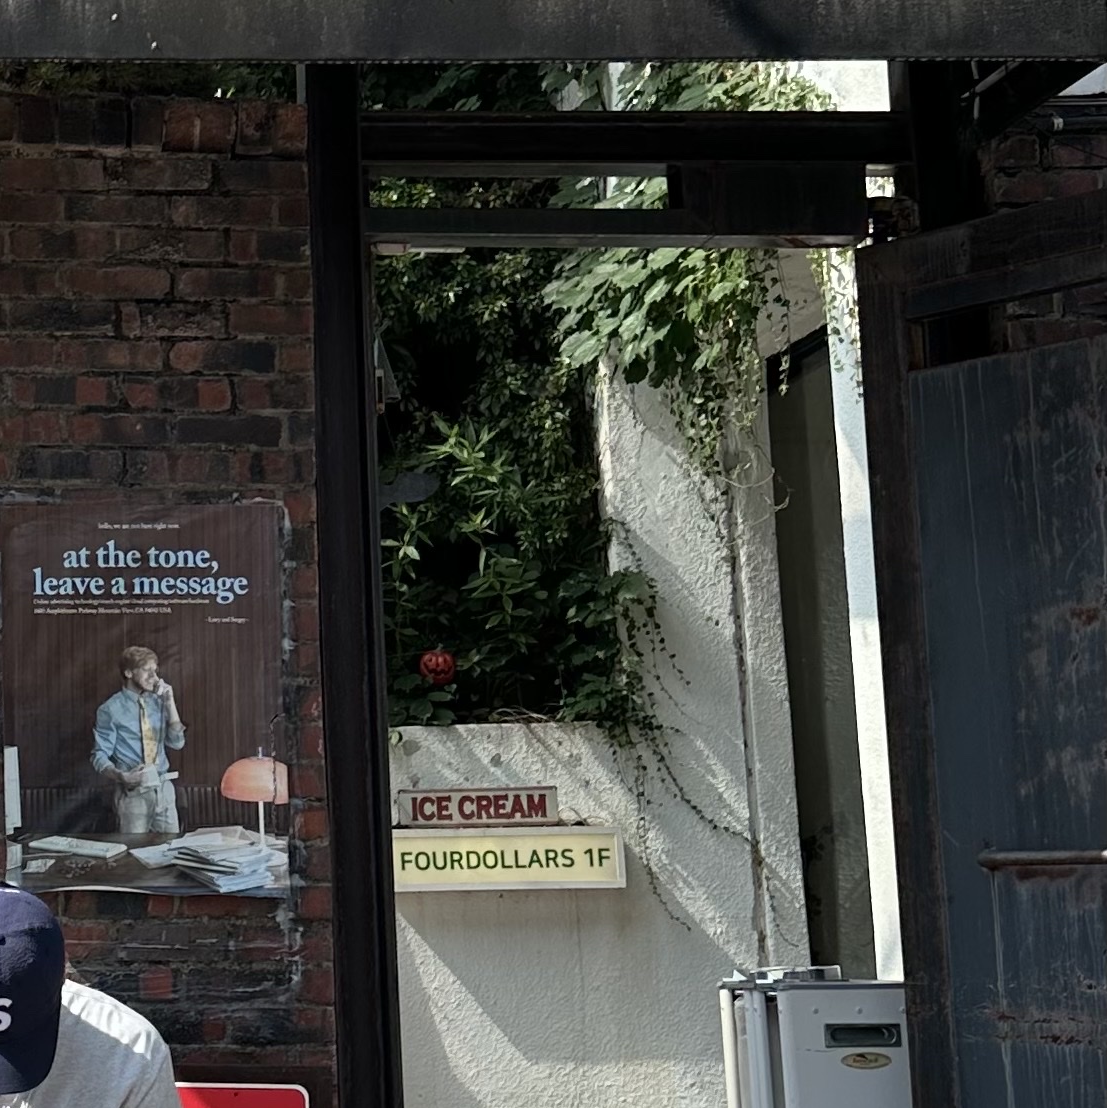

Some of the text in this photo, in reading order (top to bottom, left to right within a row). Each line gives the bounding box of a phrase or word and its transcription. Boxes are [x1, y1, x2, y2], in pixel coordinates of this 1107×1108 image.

[63, 539, 219, 574] at the tone,
[33, 567, 249, 605] leave a message
[411, 793, 548, 821] ICE CREAM
[400, 847, 611, 871] FOURDOLLARS 1F
